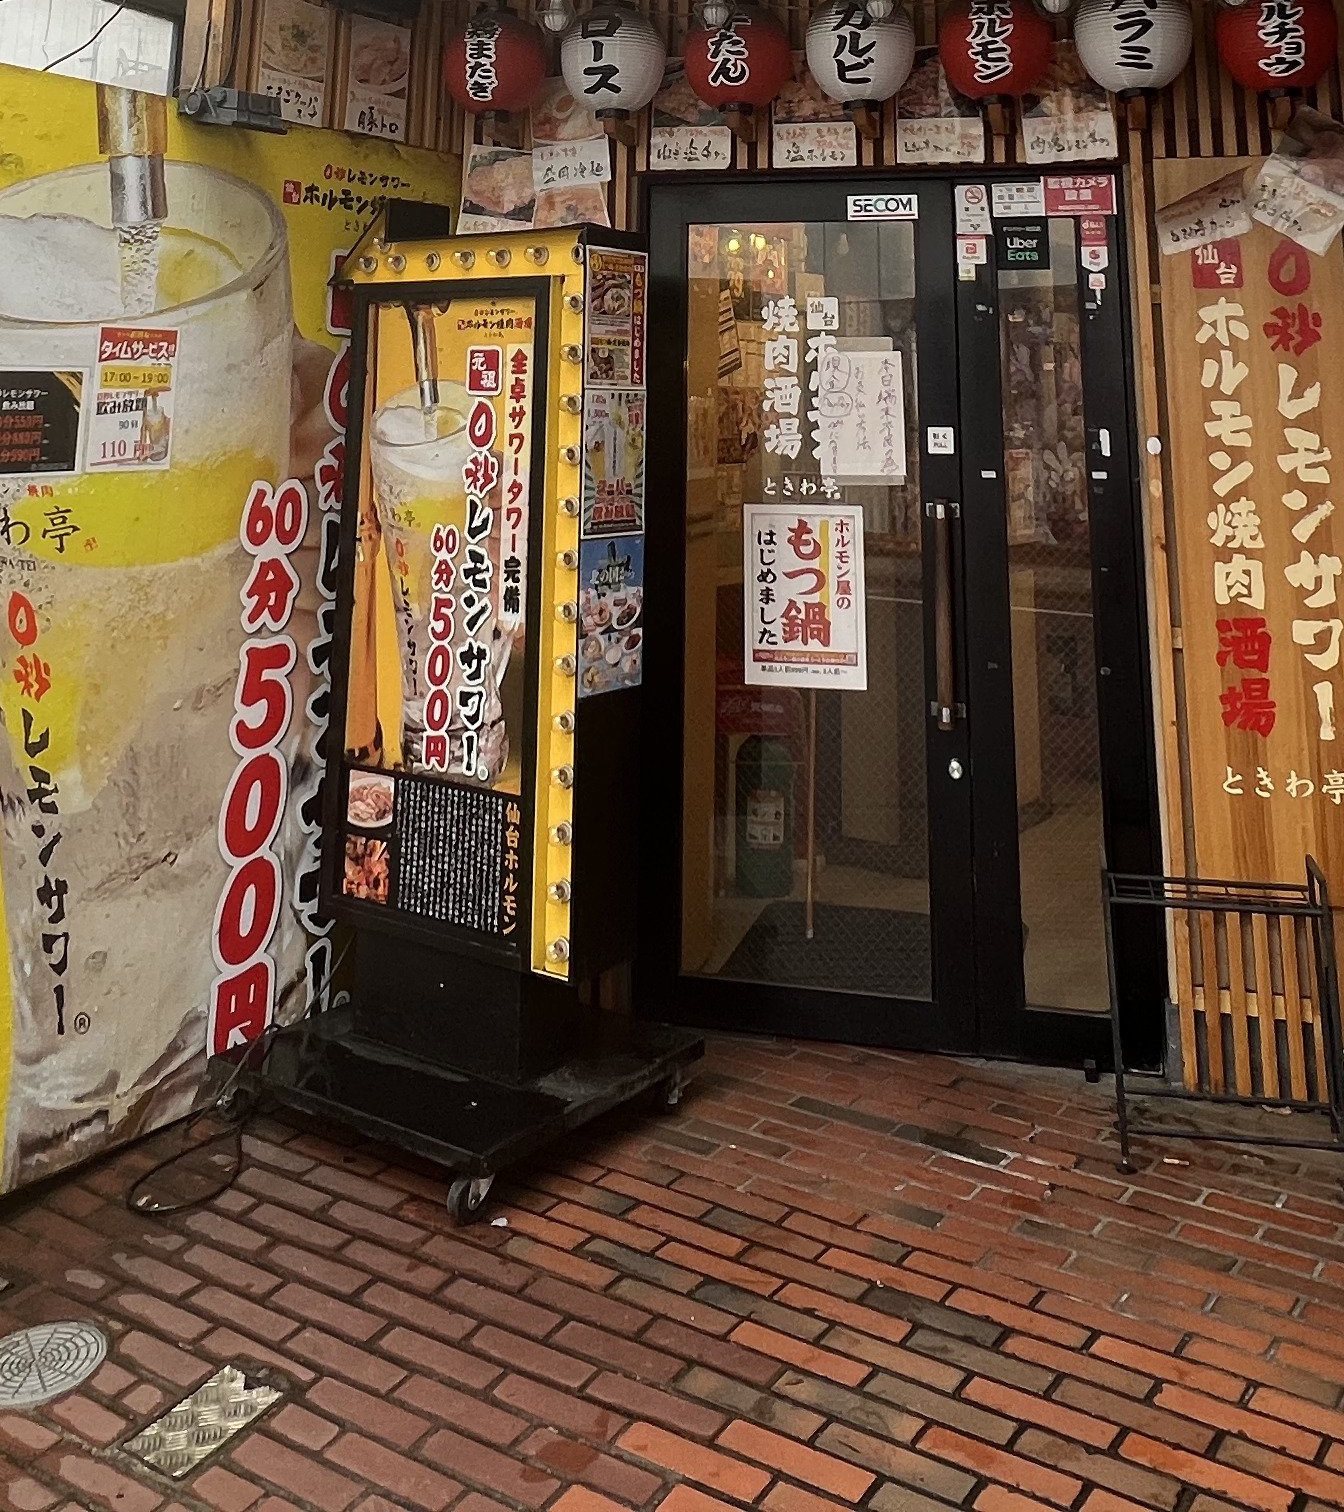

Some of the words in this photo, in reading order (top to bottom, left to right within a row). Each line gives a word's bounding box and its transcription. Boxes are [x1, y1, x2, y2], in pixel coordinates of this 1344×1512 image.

[581, 13, 623, 94] ロース
[831, 2, 876, 84] カルビ
[853, 198, 913, 212] SECOM
[1007, 237, 1038, 249] Uber
[1008, 250, 1038, 261] Eats
[1195, 297, 1277, 739] ホルモン焼肉酒場
[756, 530, 778, 645] はじめました
[782, 518, 831, 647] もつ鍋
[834, 519, 851, 609] ホルモン屋の
[503, 802, 520, 936] 仙台ホルモン
